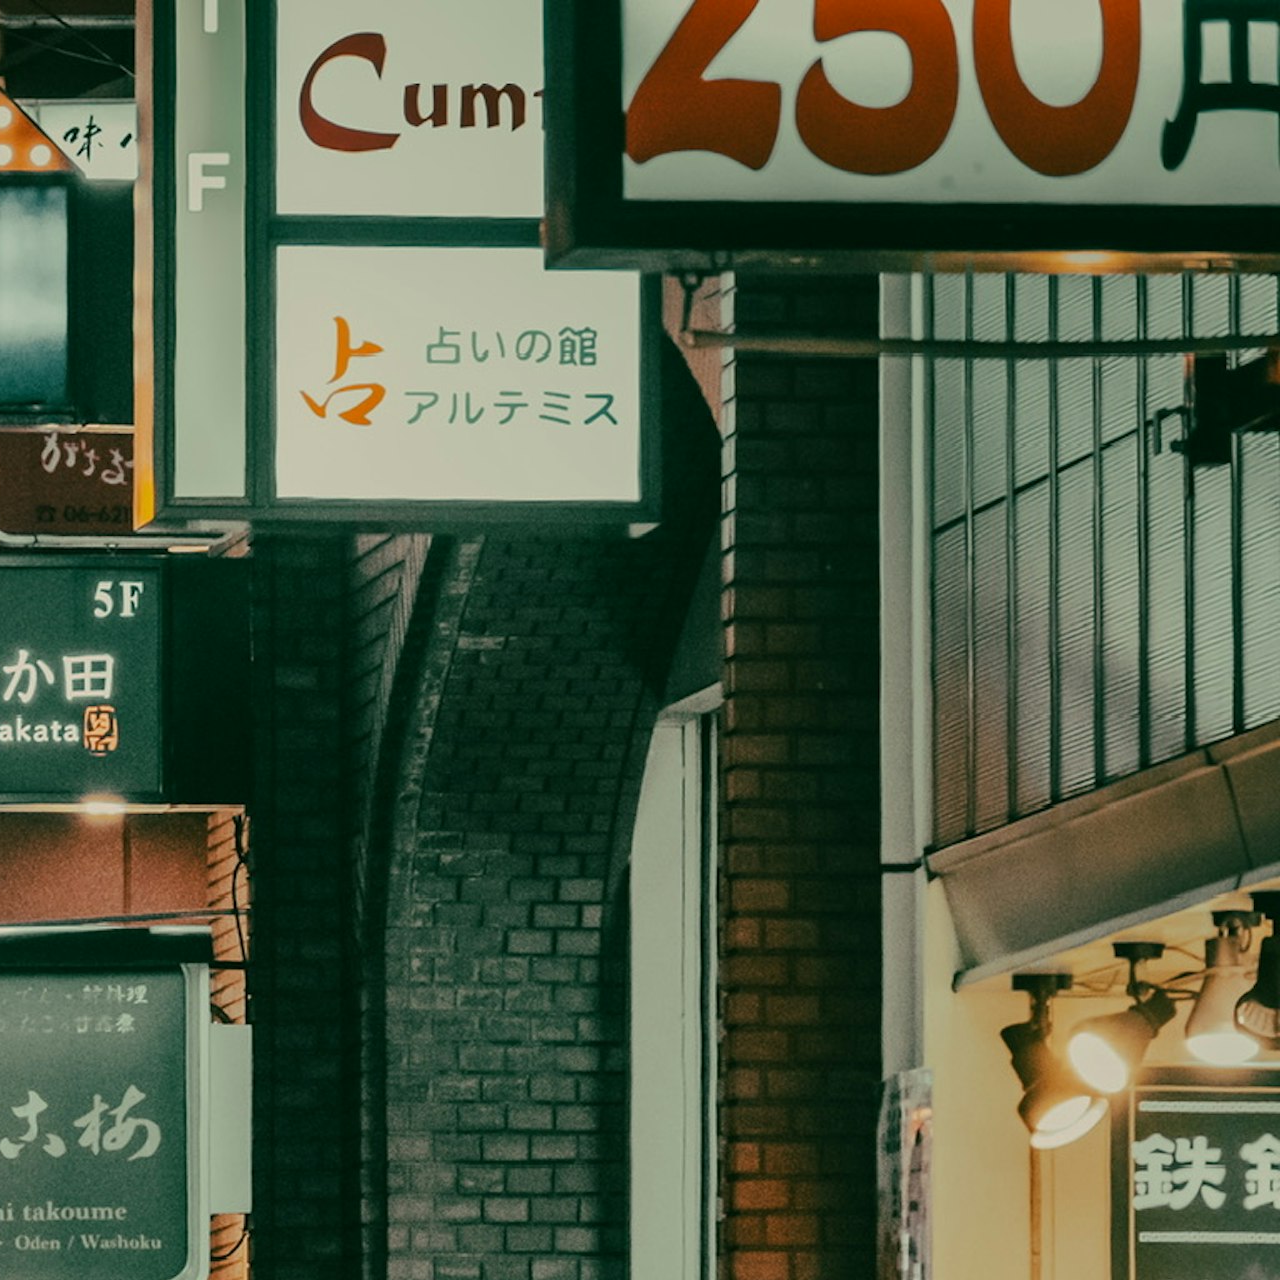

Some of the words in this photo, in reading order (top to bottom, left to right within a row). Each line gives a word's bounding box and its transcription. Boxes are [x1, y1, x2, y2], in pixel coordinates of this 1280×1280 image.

[298, 31, 544, 153] Cum
[426, 326, 598, 366] 占いの館
[404, 391, 619, 426] アルテミス
[93, 580, 144, 618] 5F
[23, 1201, 127, 1222] takoume
[15, 1234, 61, 1252] Oden
[82, 1234, 162, 1252] Washoku
